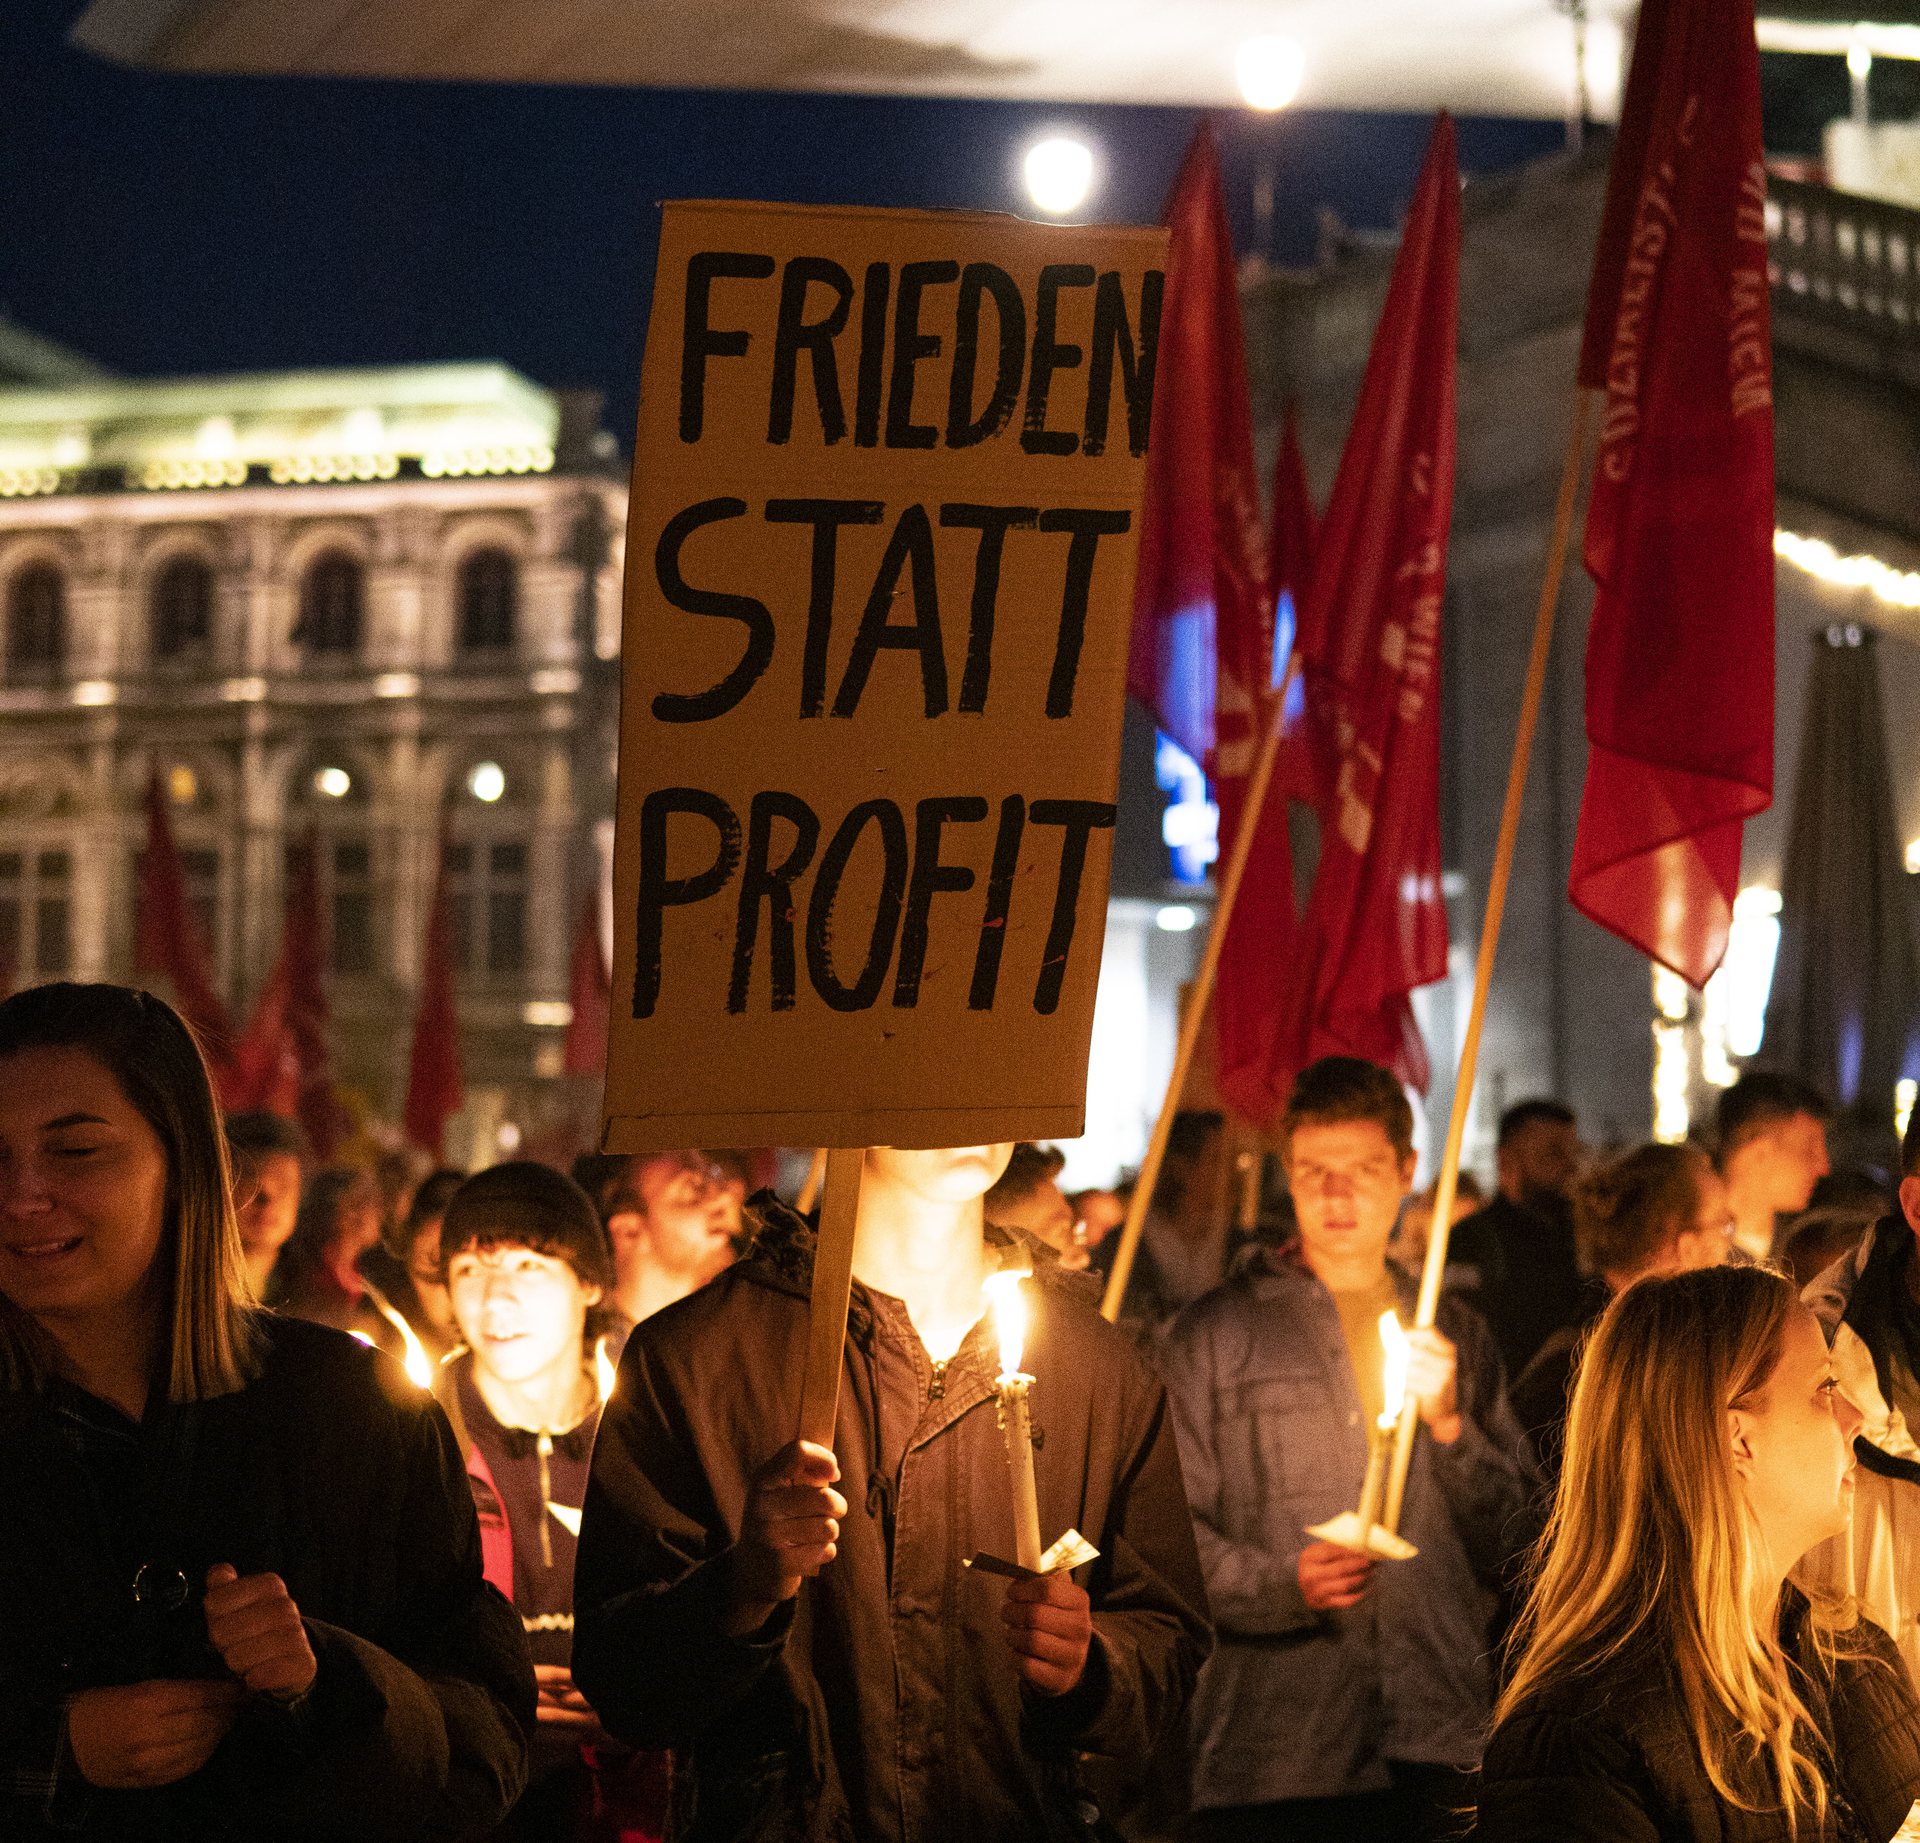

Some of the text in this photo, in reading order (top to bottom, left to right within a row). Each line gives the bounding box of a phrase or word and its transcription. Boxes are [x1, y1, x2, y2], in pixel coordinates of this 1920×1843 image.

[679, 252, 1165, 458] FRIEDEN
[651, 497, 1131, 723] STATT
[633, 788, 1117, 1019] PROFIT
